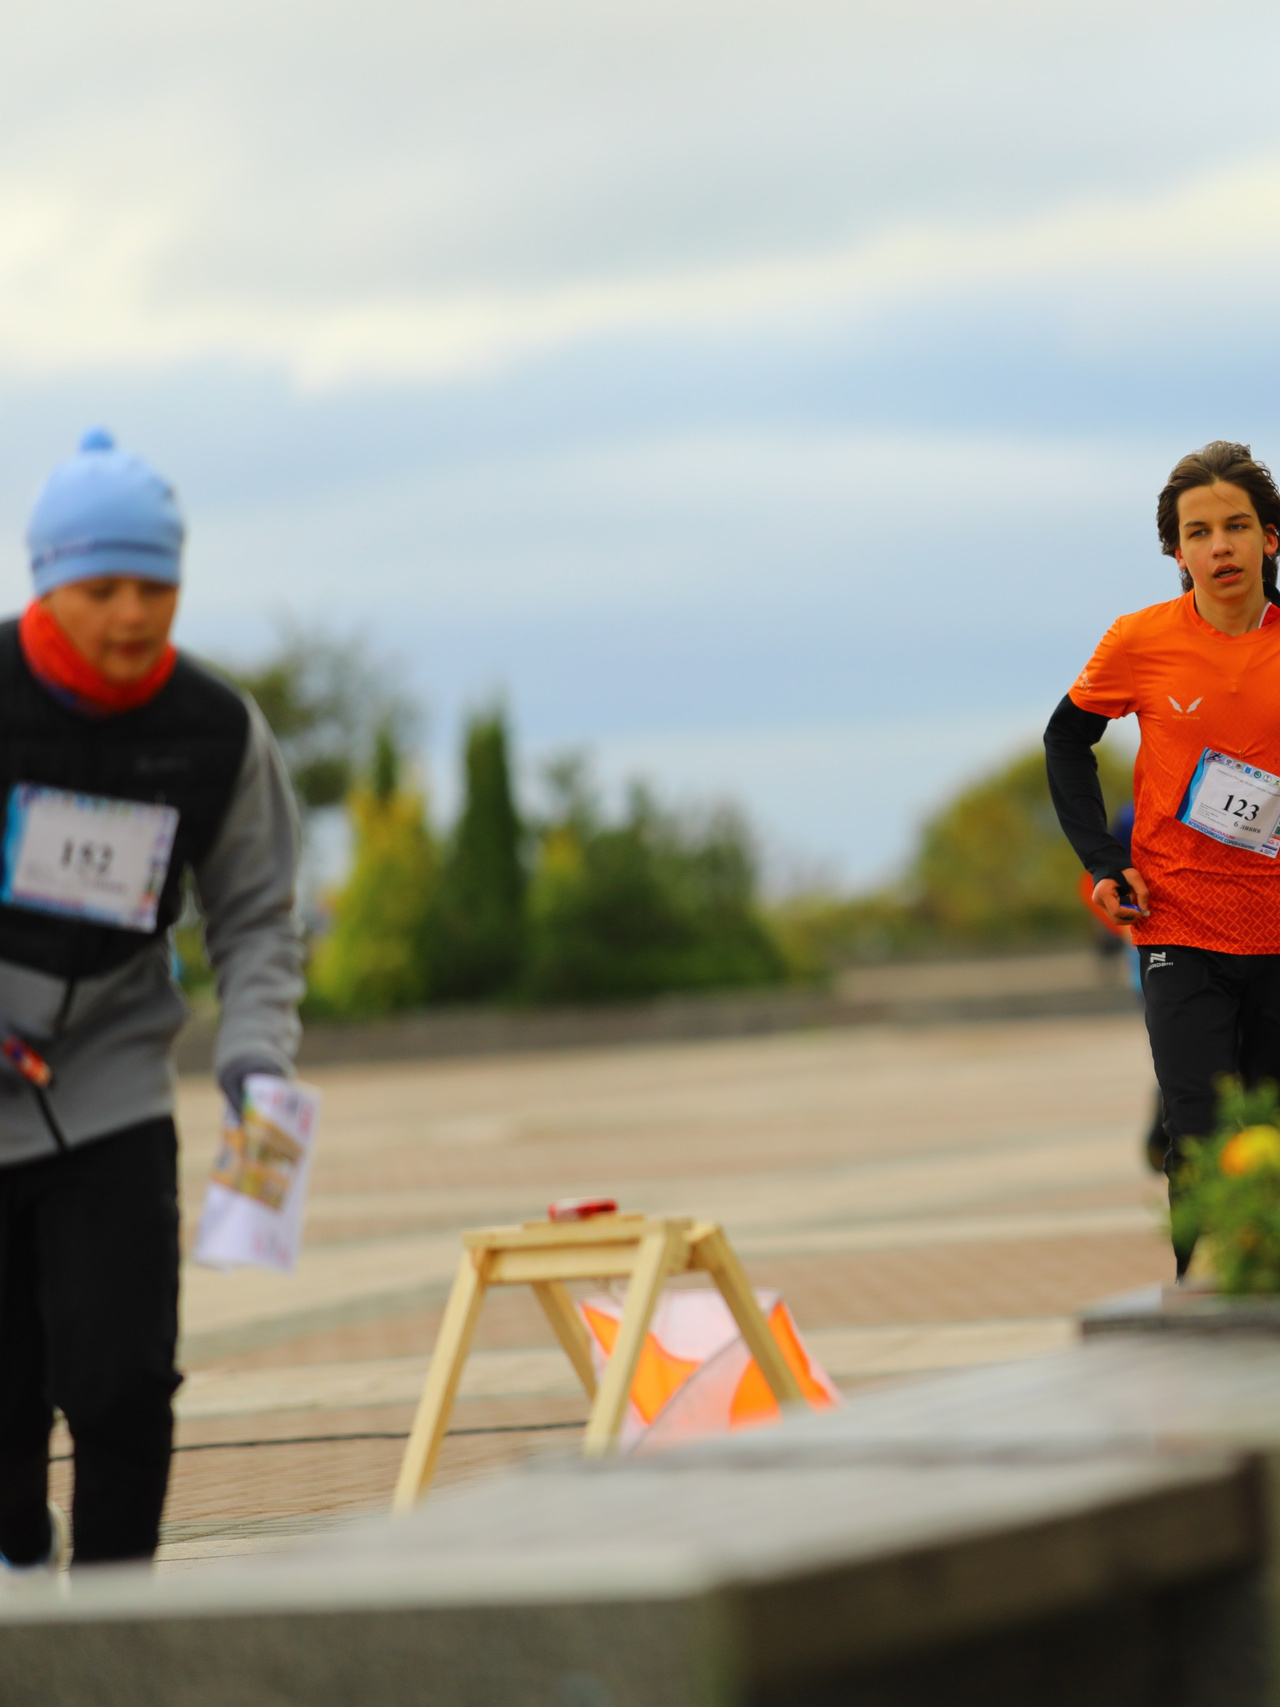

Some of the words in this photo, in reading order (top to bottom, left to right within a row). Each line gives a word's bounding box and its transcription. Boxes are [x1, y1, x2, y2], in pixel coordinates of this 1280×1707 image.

[1221, 794, 1260, 822] 123
[1233, 820, 1239, 828] 6
[1240, 824, 1261, 834] линия
[61, 838, 115, 876] 152
